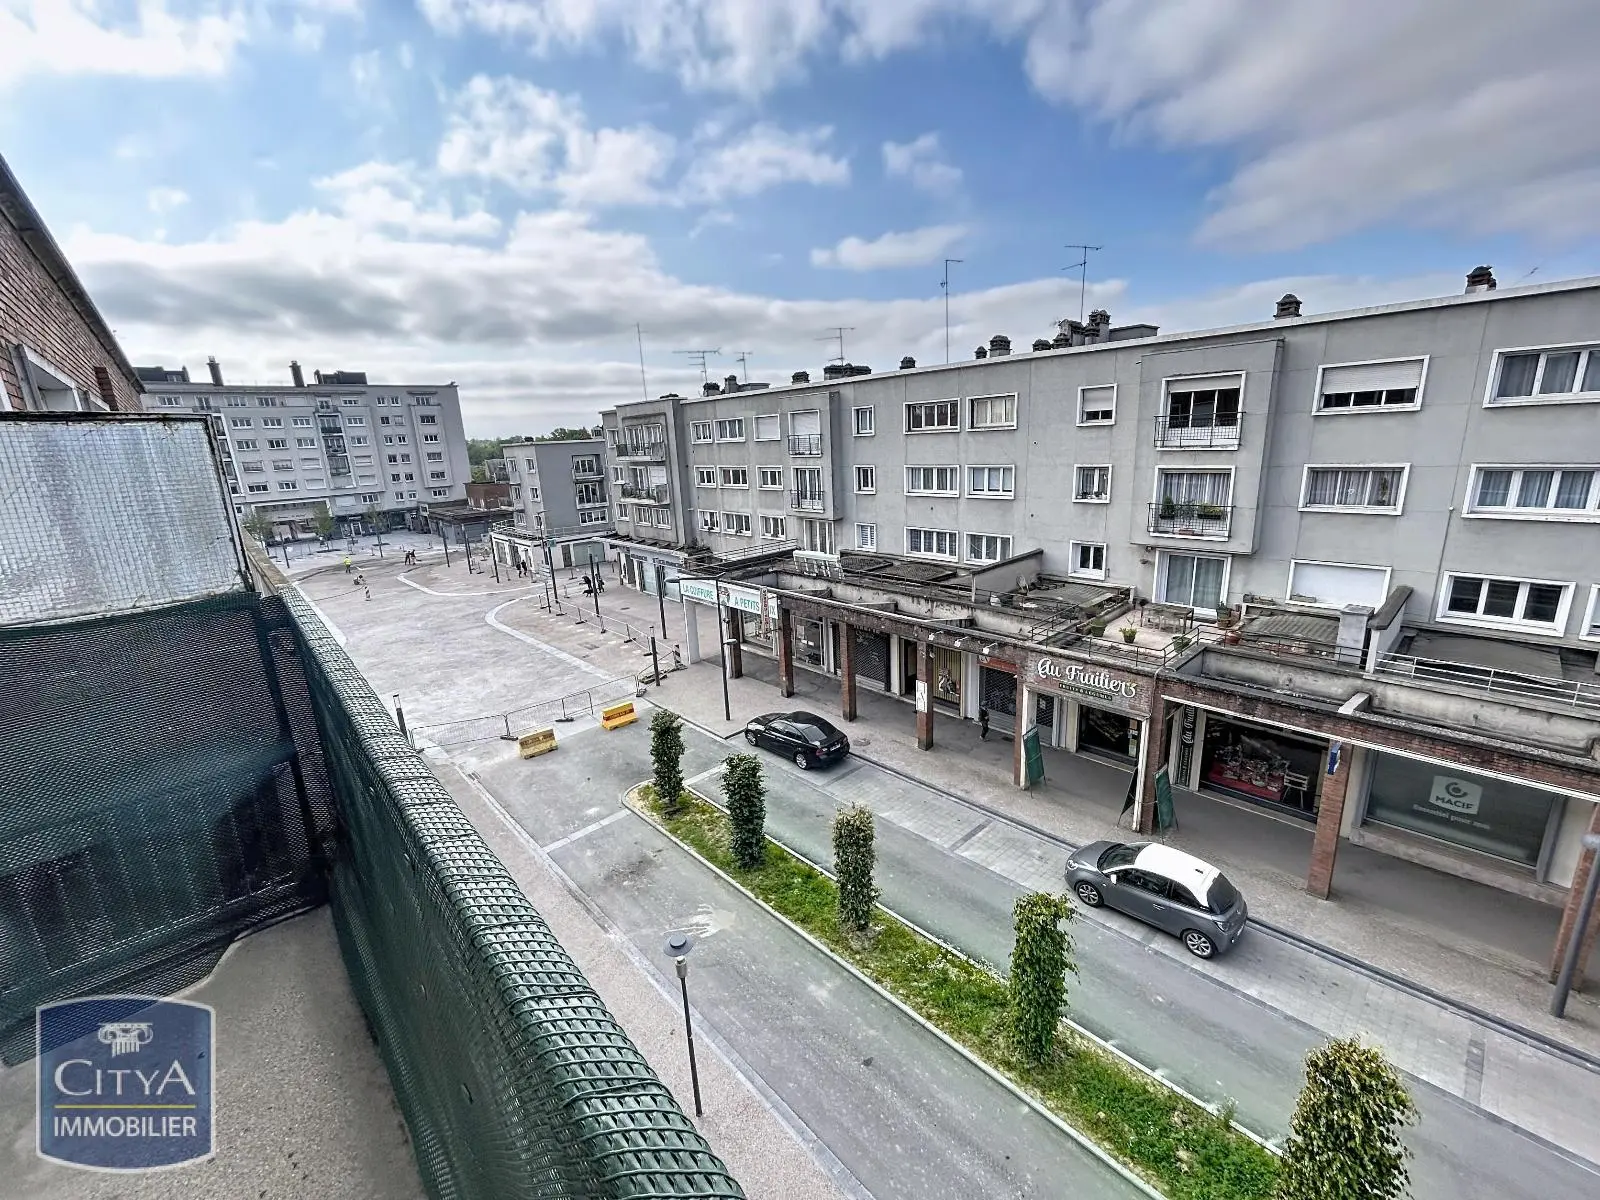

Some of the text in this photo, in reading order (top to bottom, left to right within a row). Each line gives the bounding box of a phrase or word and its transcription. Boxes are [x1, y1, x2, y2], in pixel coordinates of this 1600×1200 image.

[682, 583, 715, 600] LA COIFFURE
[734, 596, 739, 606] A
[739, 597, 760, 613] PETITS
[1037, 657, 1061, 679] Au
[1065, 665, 1138, 698] Fruitier
[1435, 795, 1474, 810] MACIF
